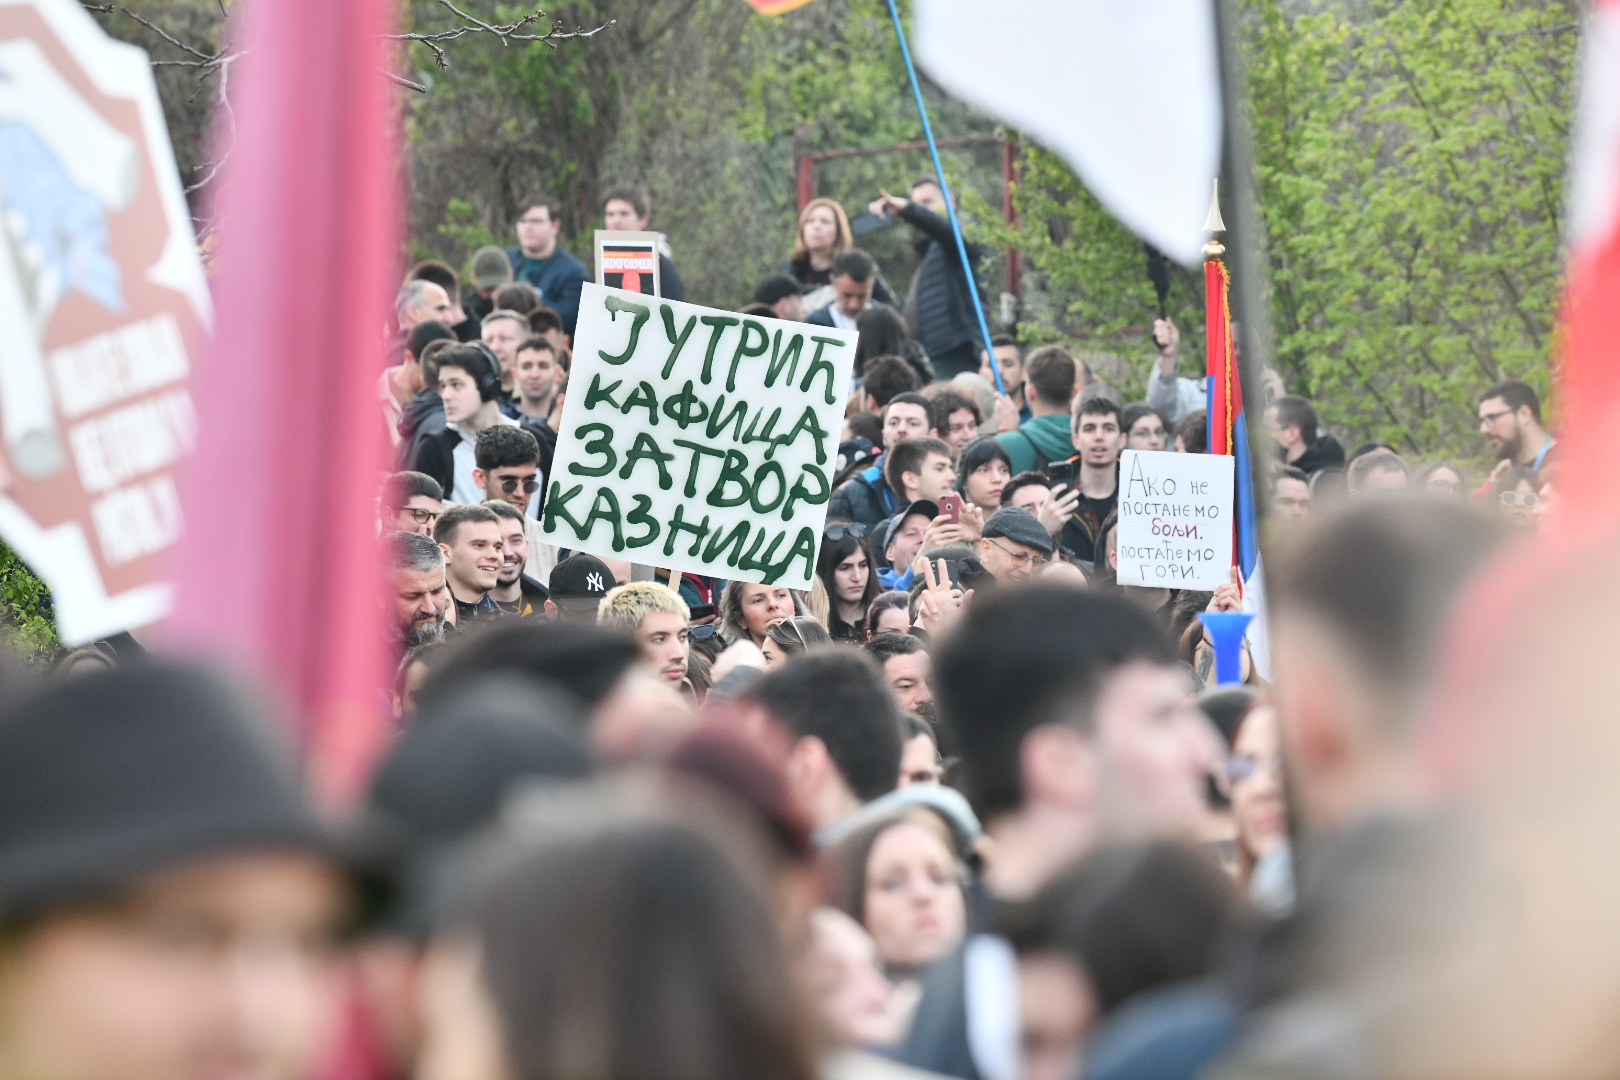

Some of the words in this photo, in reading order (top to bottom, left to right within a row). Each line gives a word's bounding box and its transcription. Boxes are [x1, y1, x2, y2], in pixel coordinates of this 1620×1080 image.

[598, 295, 847, 405] ЈУТРИЋ
[584, 373, 830, 465] КАФИЦА
[568, 423, 830, 521] ЗАТВОР
[543, 480, 816, 585] КАЗНИЦА
[586, 571, 605, 592] NY
